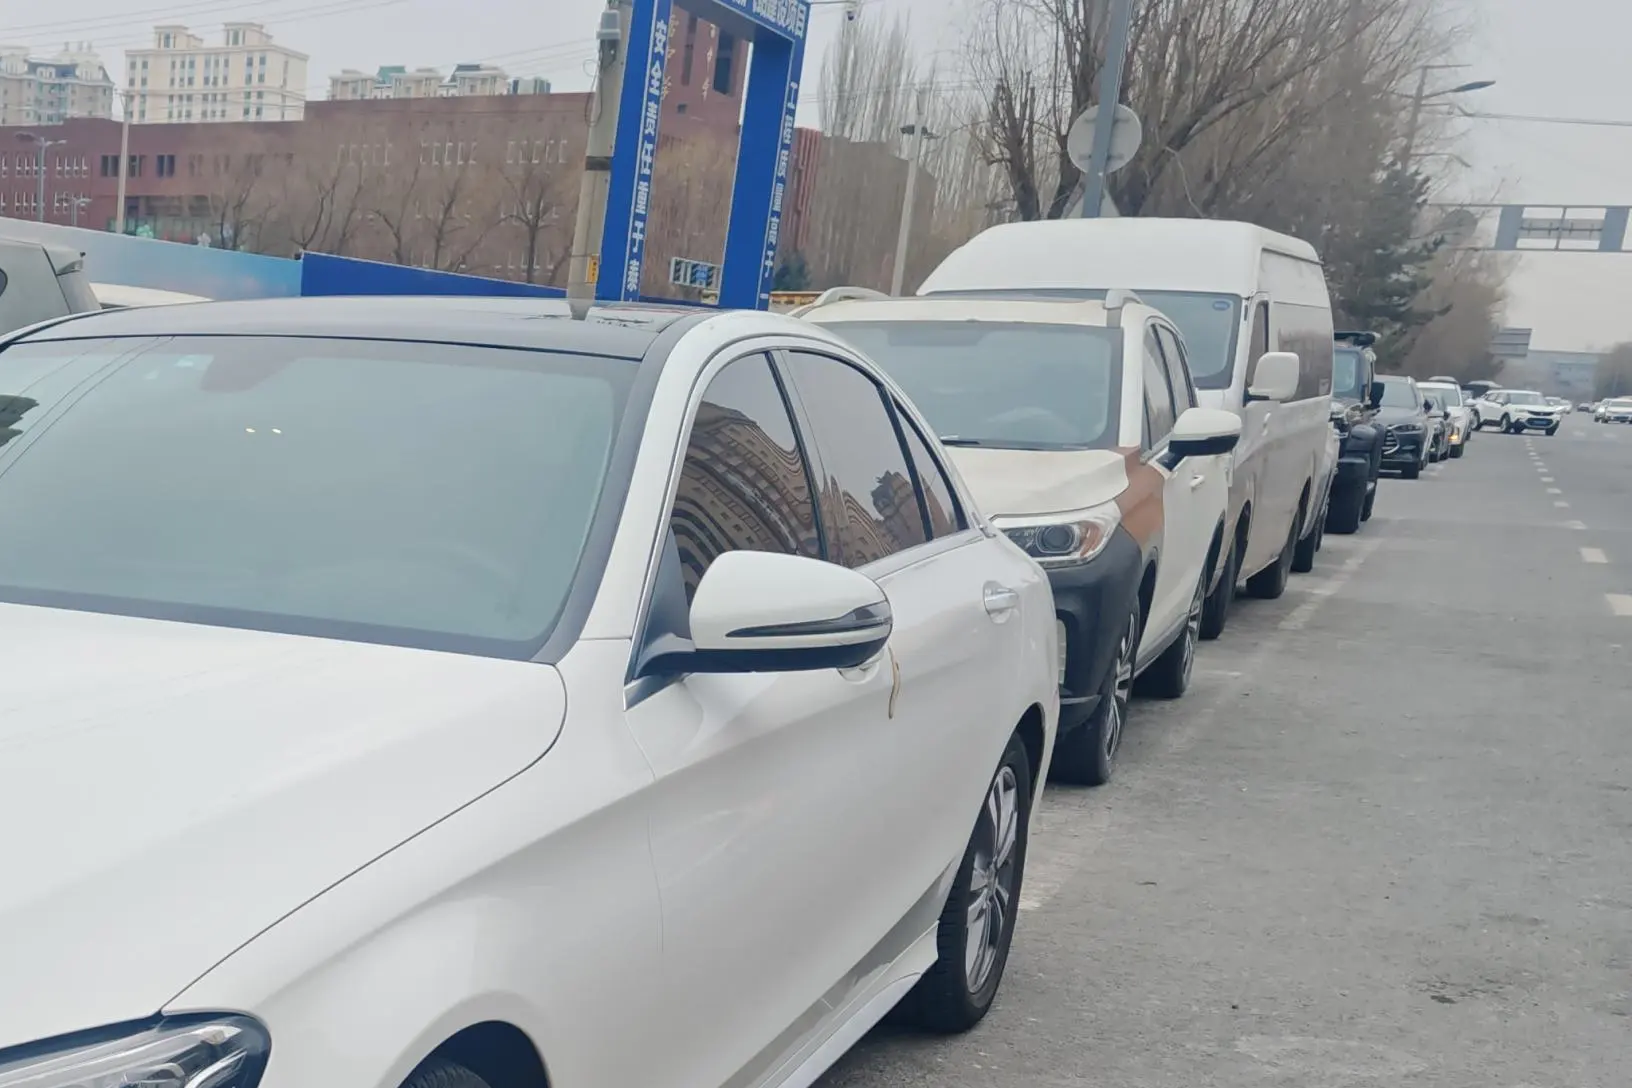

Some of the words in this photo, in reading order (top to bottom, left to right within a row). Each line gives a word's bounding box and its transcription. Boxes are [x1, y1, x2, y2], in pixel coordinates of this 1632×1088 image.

[626, 19, 668, 299] 安全责任重于泰
